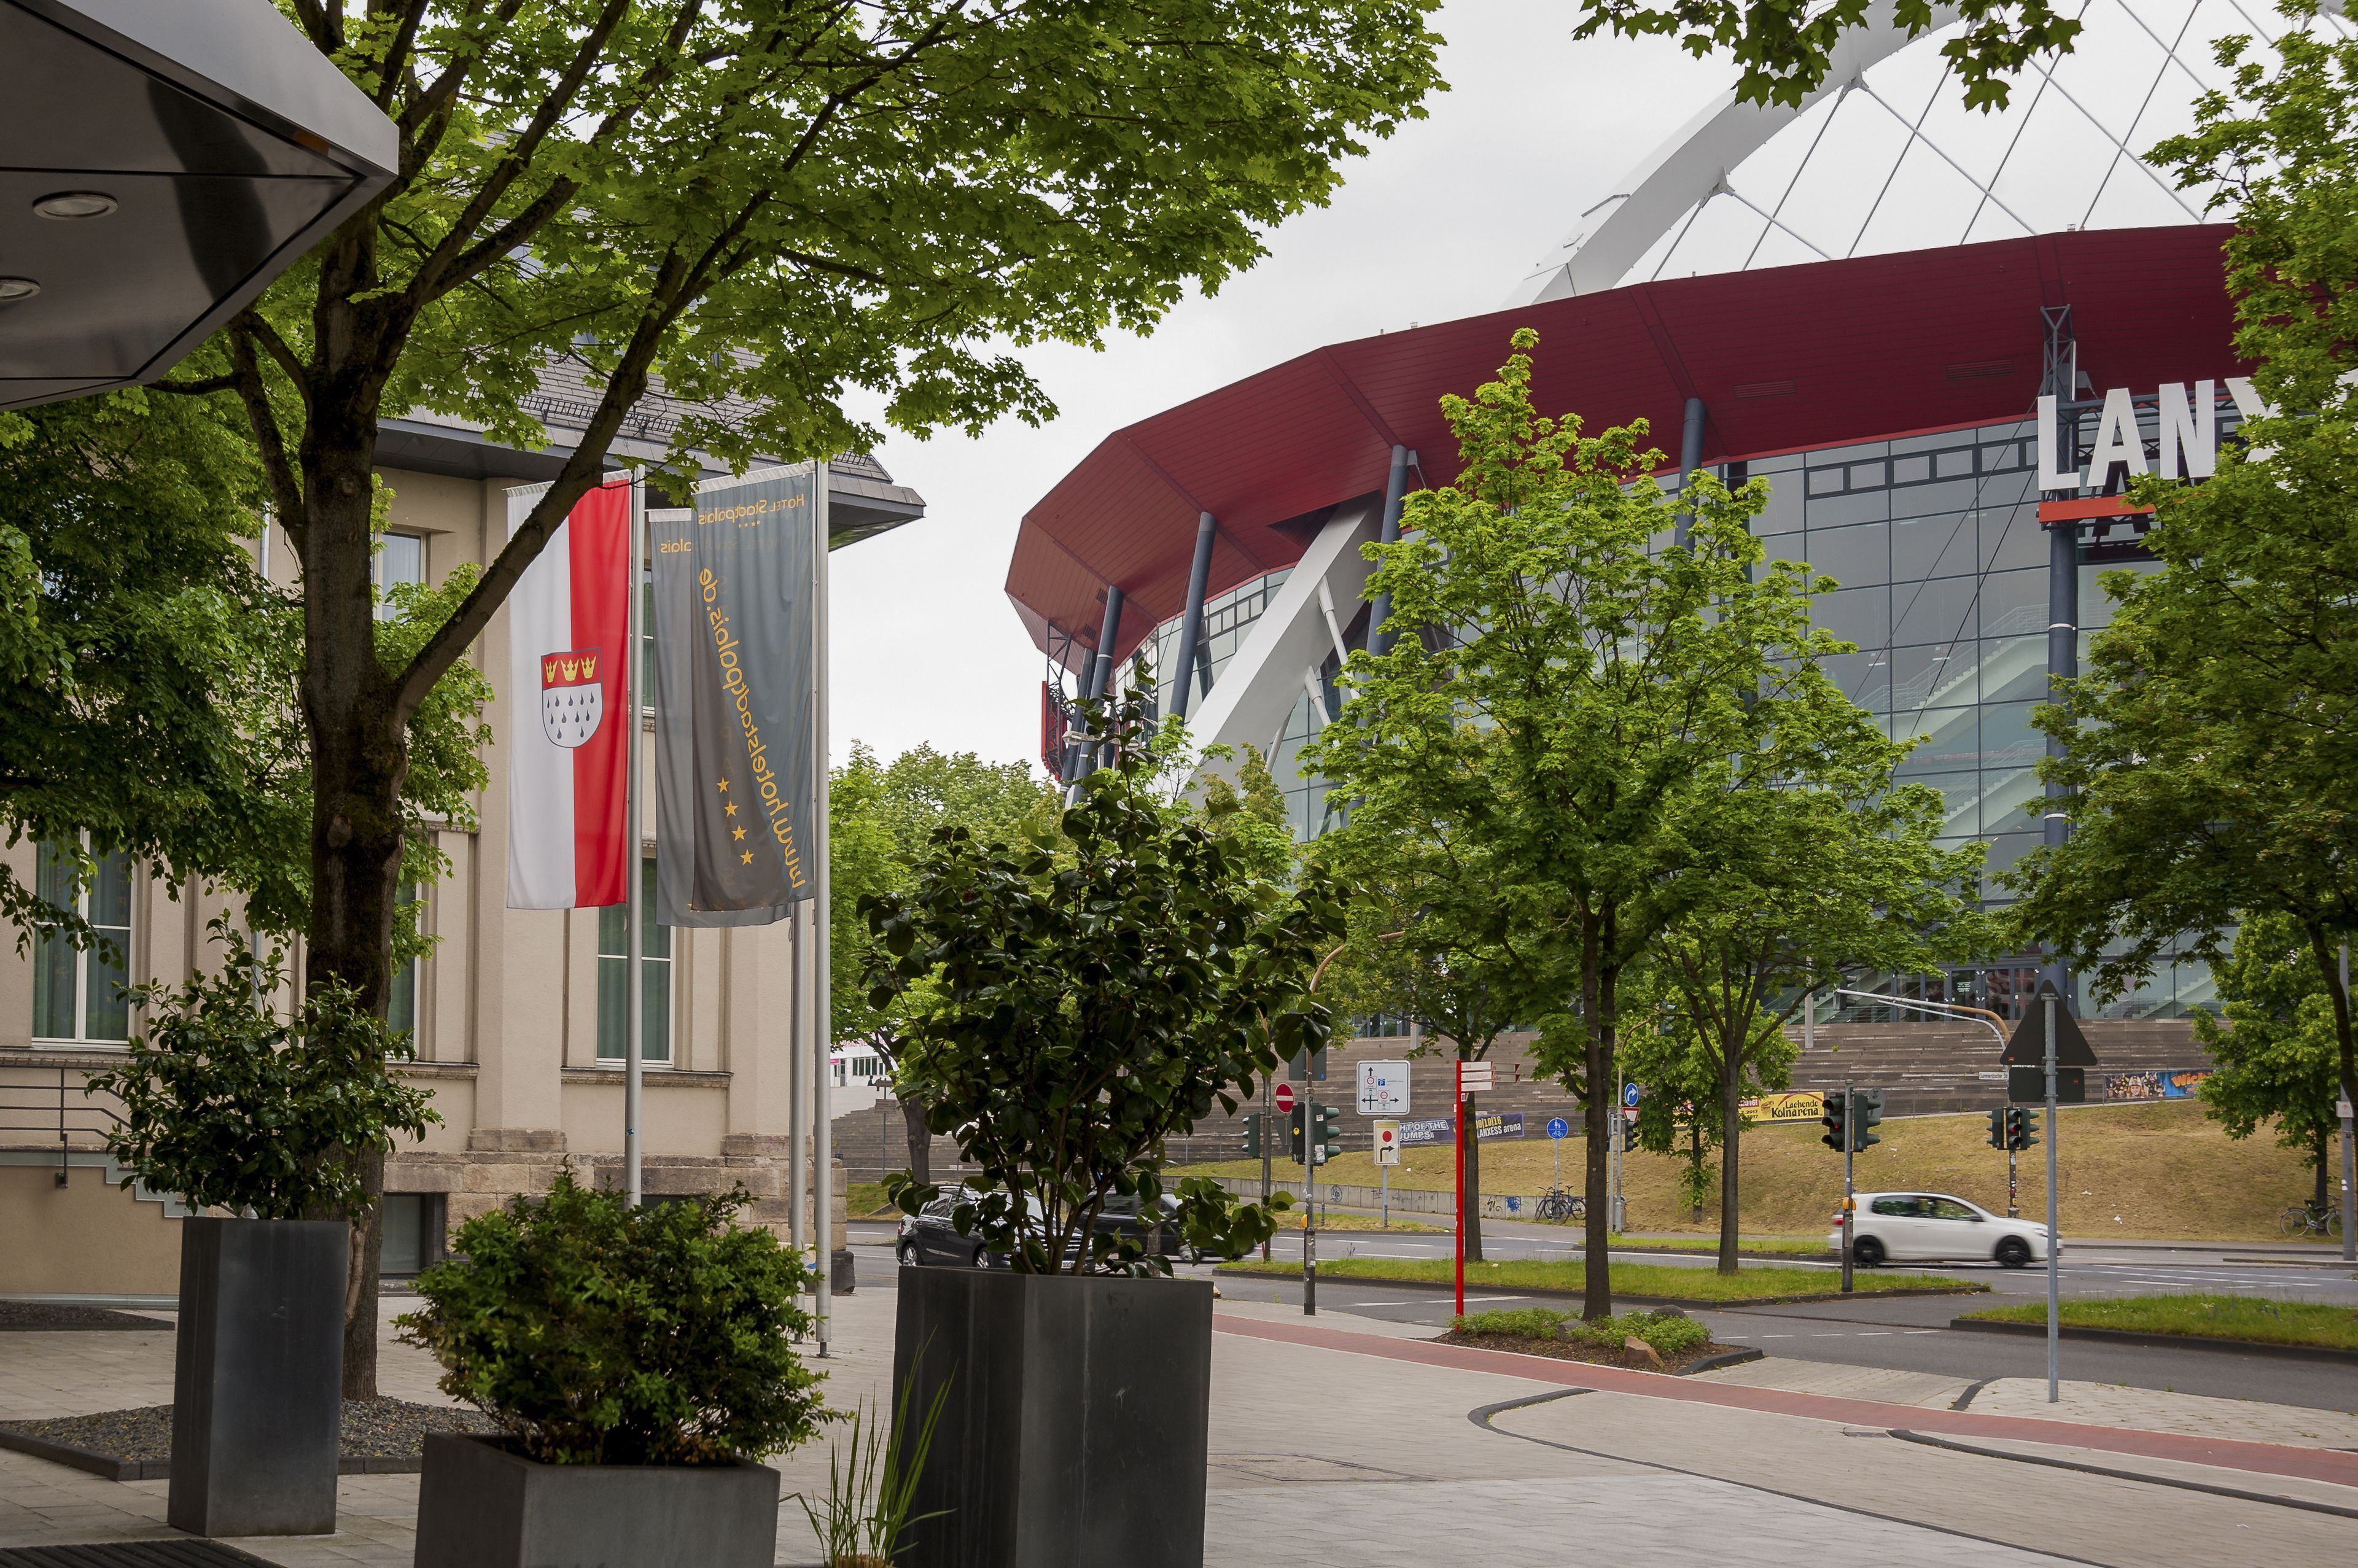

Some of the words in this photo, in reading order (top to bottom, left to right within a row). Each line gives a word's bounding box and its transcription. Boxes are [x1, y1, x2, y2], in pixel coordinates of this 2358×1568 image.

[1785, 1099, 1818, 1109] Lachende
[1414, 1122, 1425, 1131] OF
[1428, 1121, 1447, 1130] THE
[1503, 1123, 1522, 1133] arena
